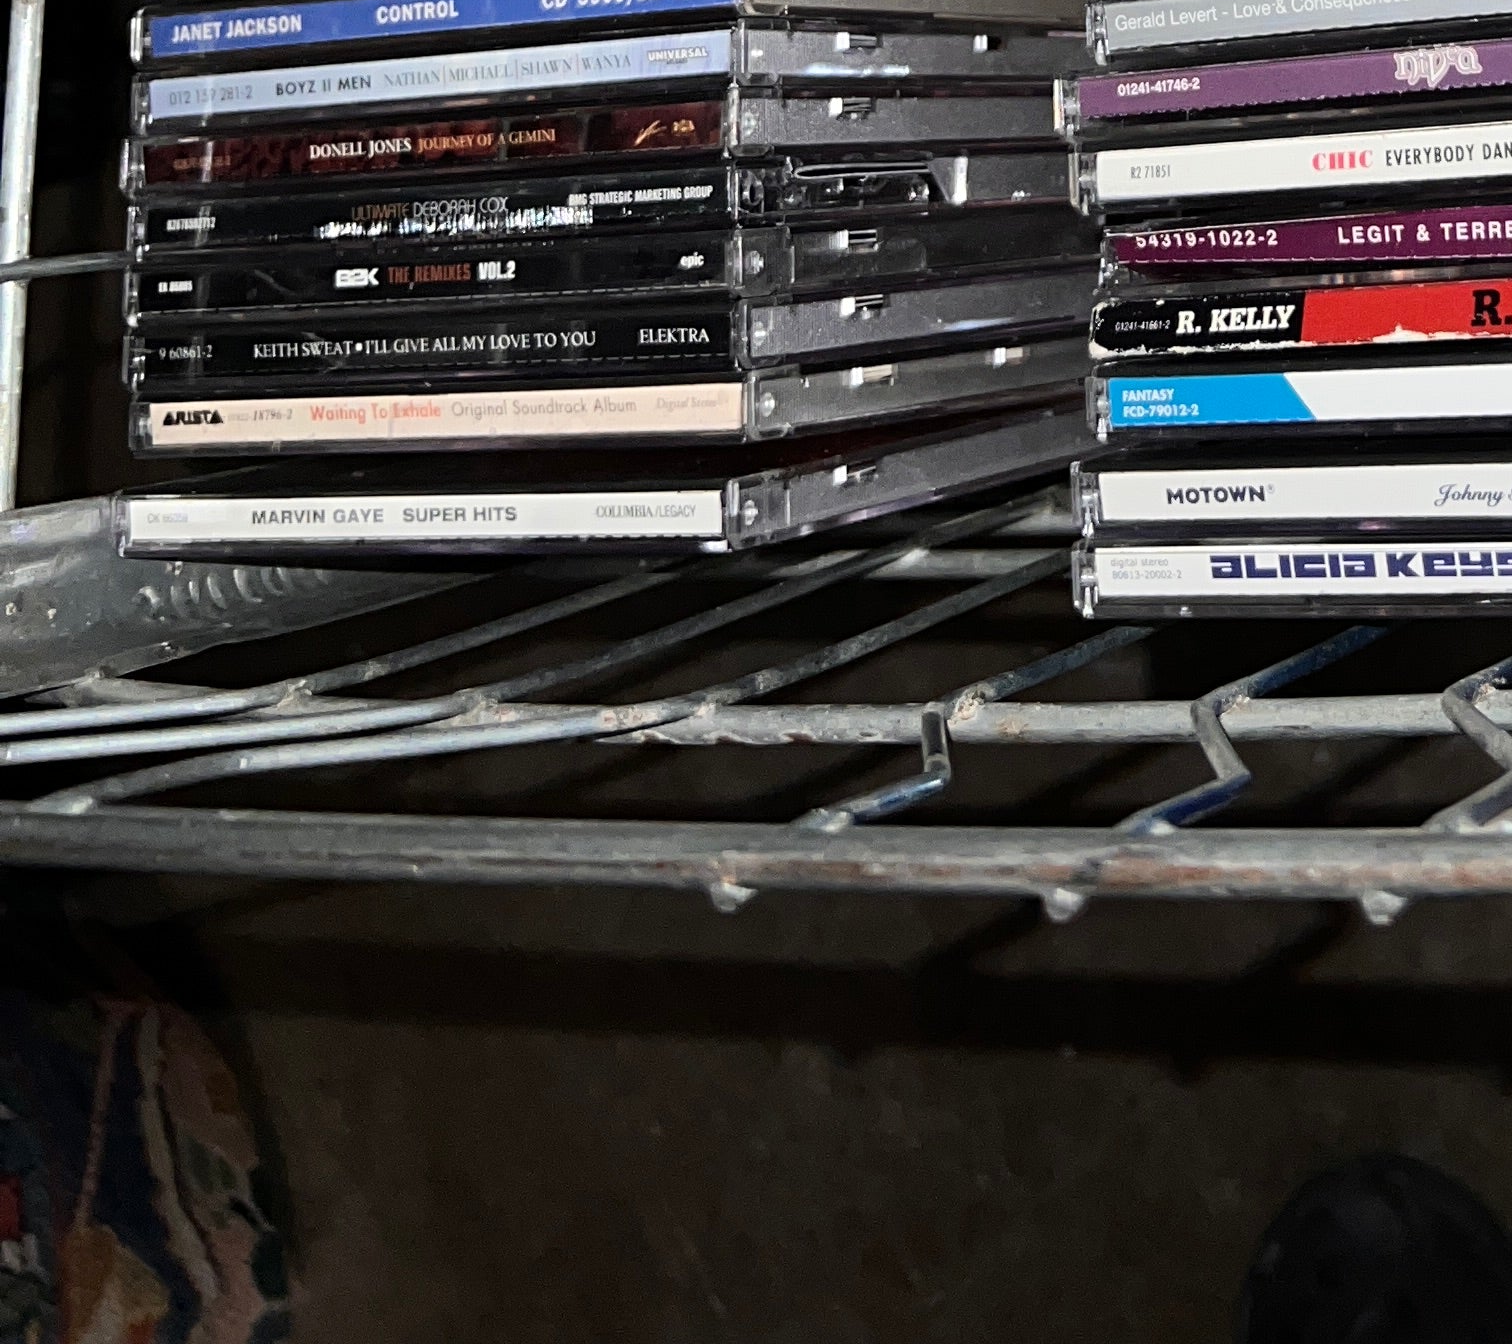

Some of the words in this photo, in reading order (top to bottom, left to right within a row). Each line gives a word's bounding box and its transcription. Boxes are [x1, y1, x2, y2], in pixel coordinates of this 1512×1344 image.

[1114, 11, 1165, 31] Gerald
[1170, 5, 1218, 25] Levert
[1233, 1, 1272, 18] Love
[1275, 1, 1286, 13] &
[171, 22, 221, 43] JANET
[227, 15, 302, 38] JACKSON
[1117, 77, 1200, 97] 01241-41746-2
[1312, 150, 1374, 171] CHIC
[1385, 144, 1474, 167] EVERYBODY
[1337, 224, 1404, 244] LEGIT
[1416, 223, 1430, 242] &
[1176, 311, 1201, 334] R.
[1209, 304, 1295, 333] KELLY
[254, 343, 298, 358] KEITH
[302, 341, 353, 356] SWEAT
[394, 338, 429, 352] GIVE
[432, 334, 460, 351] ALL
[463, 334, 486, 350] MY
[490, 333, 530, 349] LOVE
[534, 332, 557, 347] TO
[560, 331, 596, 346] YOU
[639, 328, 709, 344] ELEKTRA
[1122, 389, 1174, 402] FANTASY
[310, 404, 366, 424] Waiting
[371, 403, 387, 419] To
[393, 400, 441, 418] Exhale
[451, 399, 507, 419] Original
[512, 398, 586, 415] Soundtrack
[594, 396, 636, 412] Album
[1123, 404, 1199, 418] FCD-79012-2
[1434, 484, 1503, 507] Johnny
[252, 509, 325, 524] MARVIN
[333, 508, 384, 524] GAYE
[402, 507, 466, 523] SUPER
[474, 506, 517, 521] HITS
